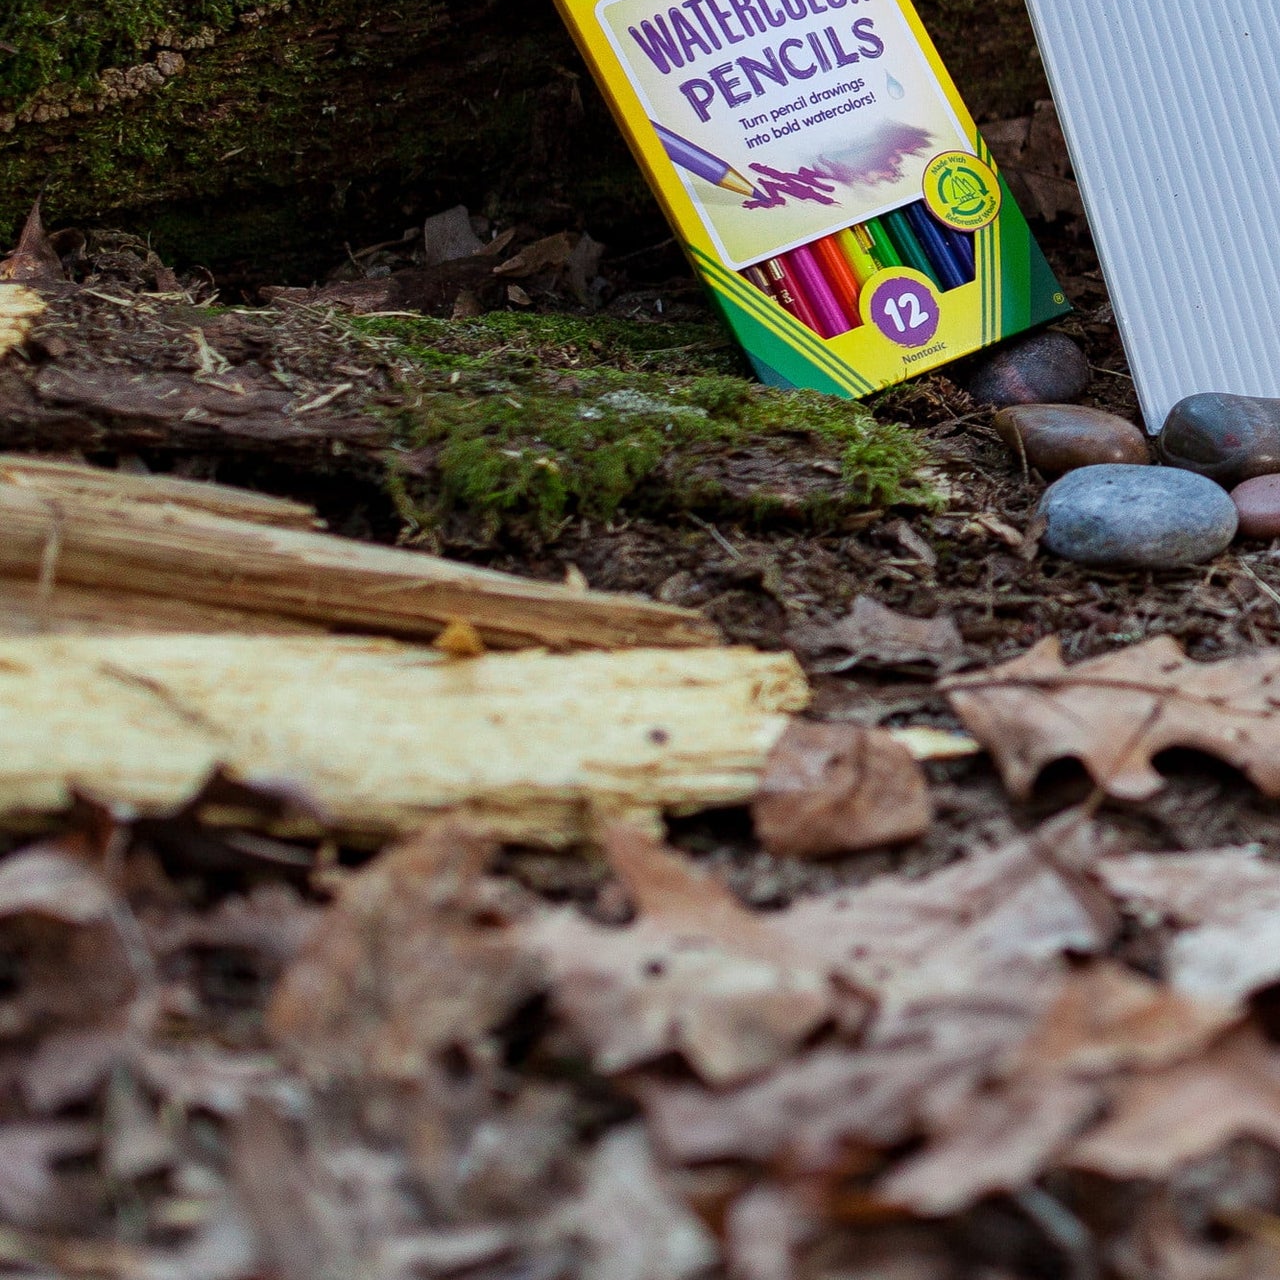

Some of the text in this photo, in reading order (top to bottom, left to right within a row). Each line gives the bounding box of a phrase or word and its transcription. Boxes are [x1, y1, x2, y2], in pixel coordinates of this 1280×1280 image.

[679, 17, 885, 123] PENCILS
[739, 77, 865, 130] Turn pencil drawings
[744, 91, 877, 149] into bold watercolors!
[931, 156, 966, 175] Made With
[884, 293, 929, 332] 12
[902, 341, 948, 365] Nontoxic
